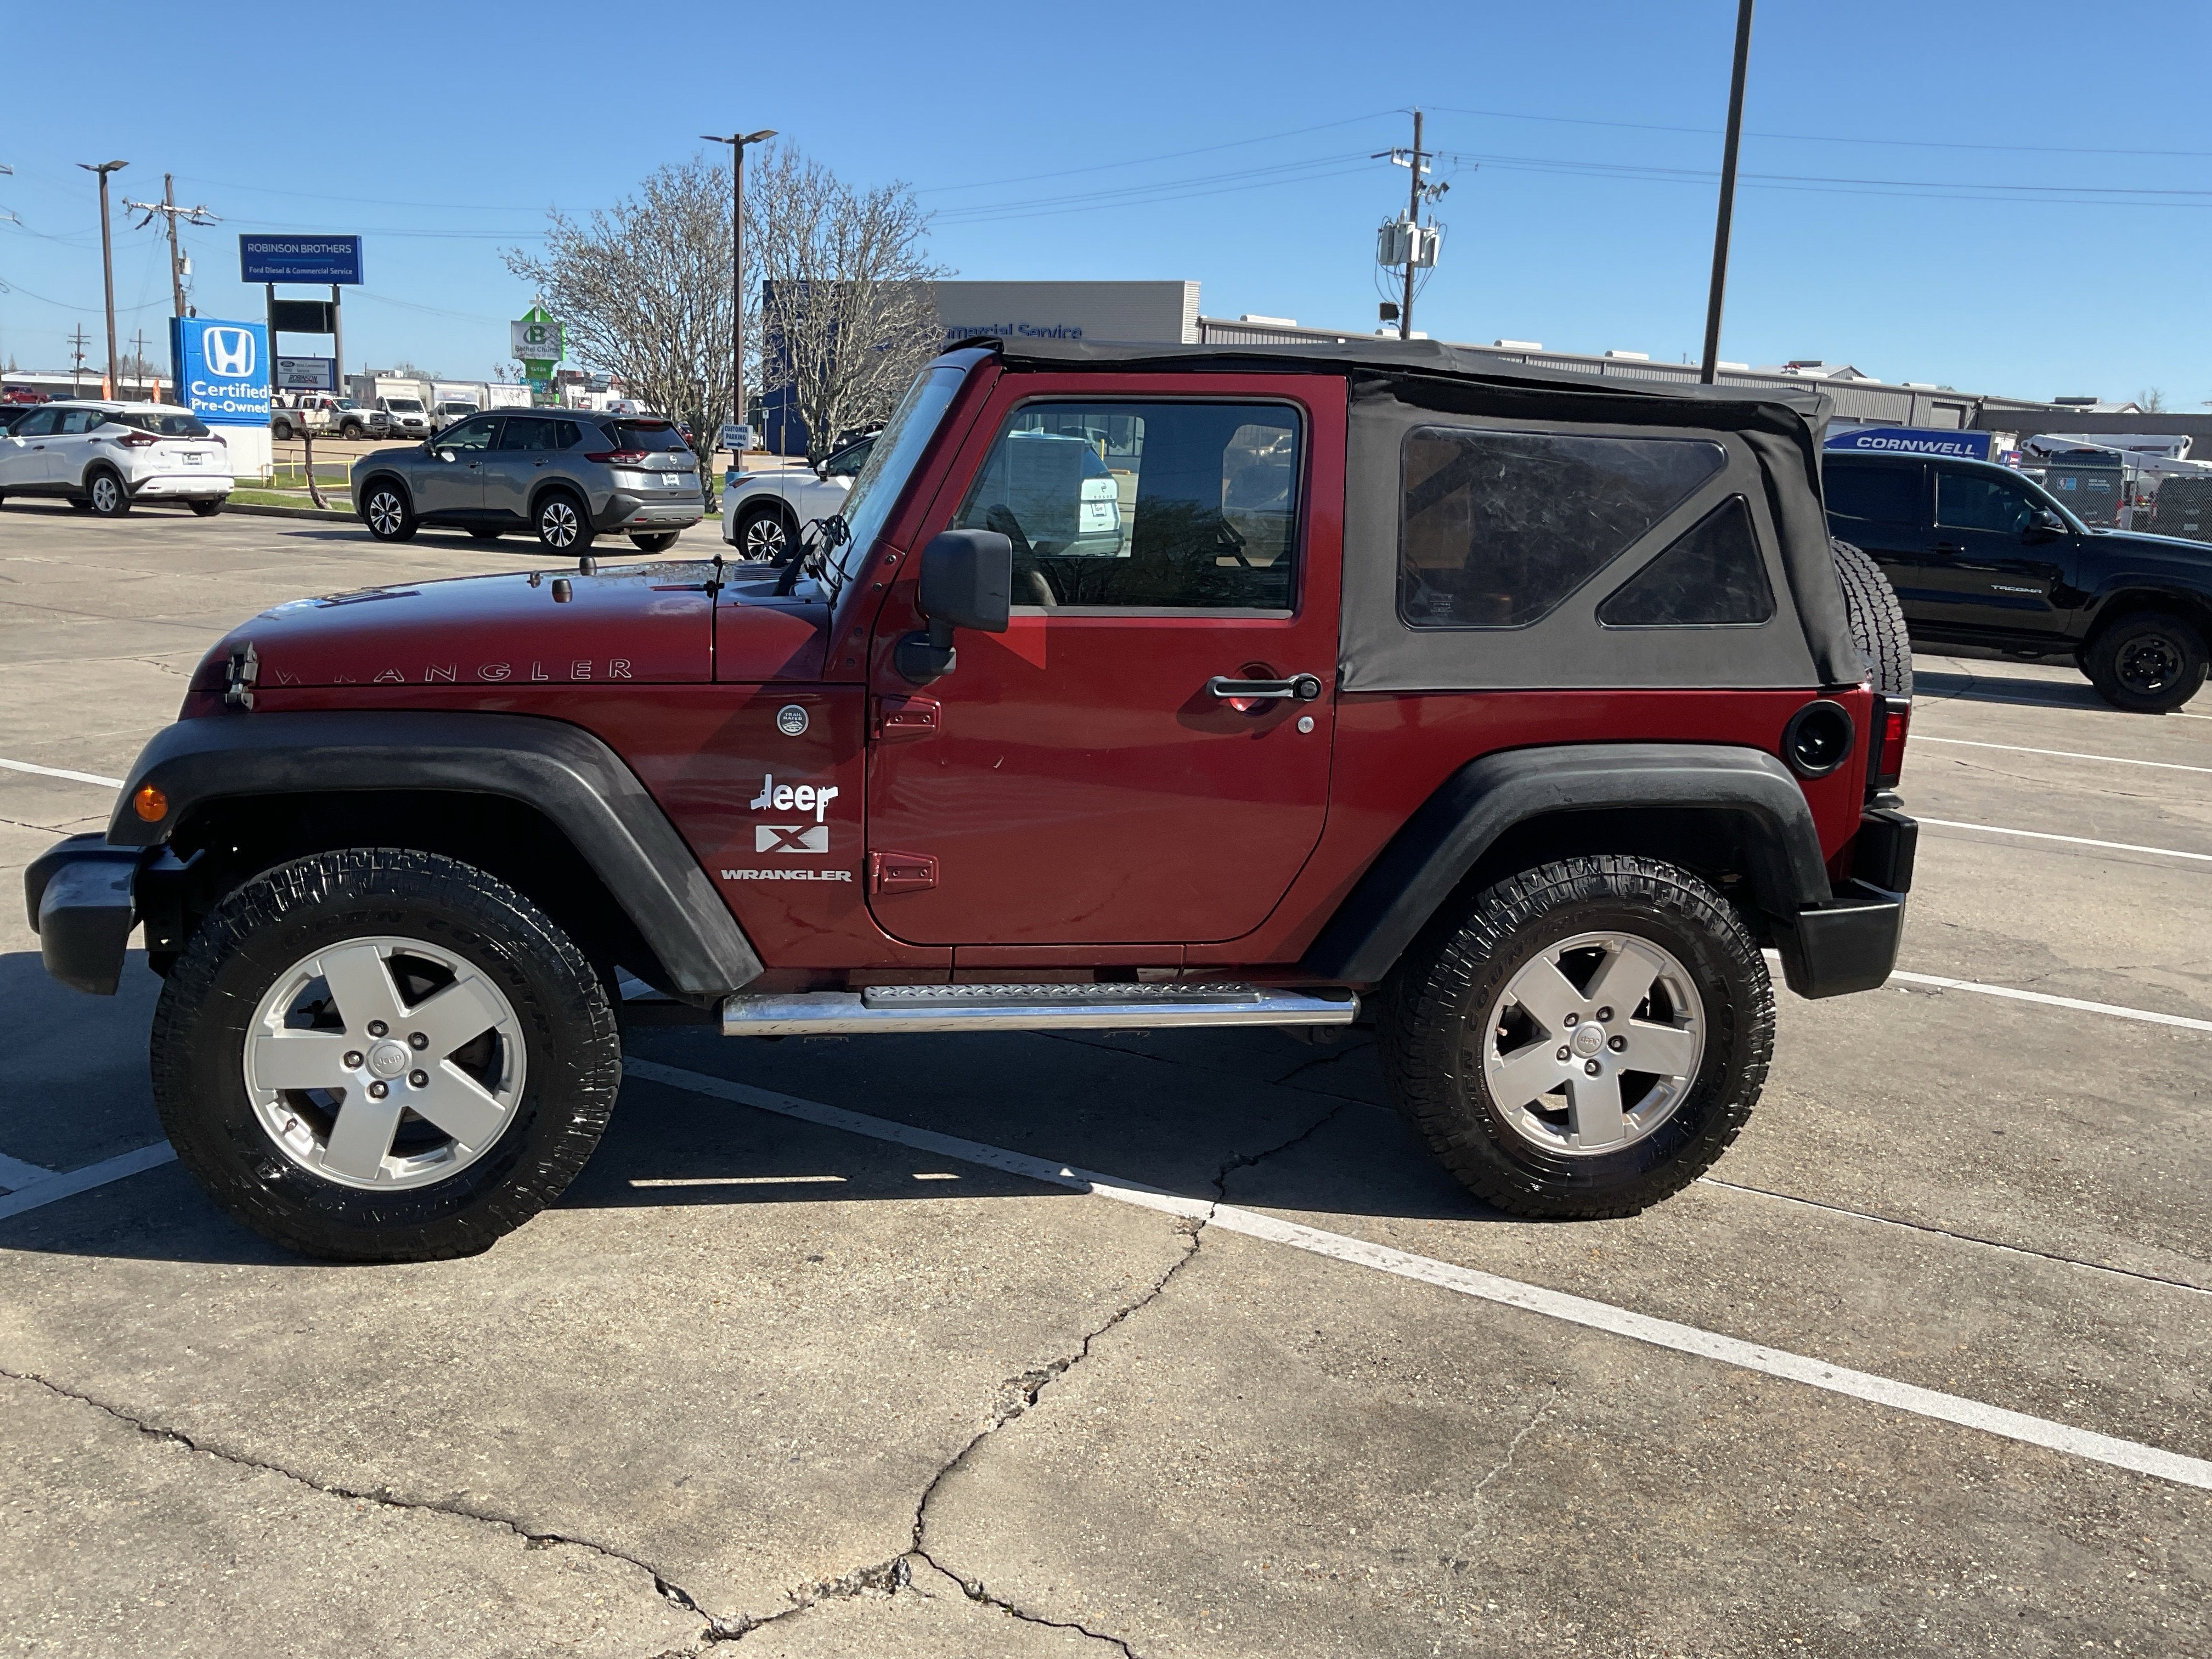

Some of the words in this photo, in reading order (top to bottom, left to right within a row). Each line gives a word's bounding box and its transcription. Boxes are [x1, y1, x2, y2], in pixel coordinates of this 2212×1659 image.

[247, 243, 299, 252] ROBINSON
[301, 244, 352, 253] BROTHERS
[943, 323, 1013, 339] mercial
[1018, 323, 1082, 339] Service
[191, 380, 268, 399] Certified
[191, 398, 268, 414] Pre-Owned
[725, 425, 748, 433] CUSTOMER
[1856, 437, 1975, 455] CORNWELL
[1991, 584, 2042, 594] TACOMA
[720, 869, 853, 882] WRANGLER
[377, 1054, 402, 1066] Jeep
